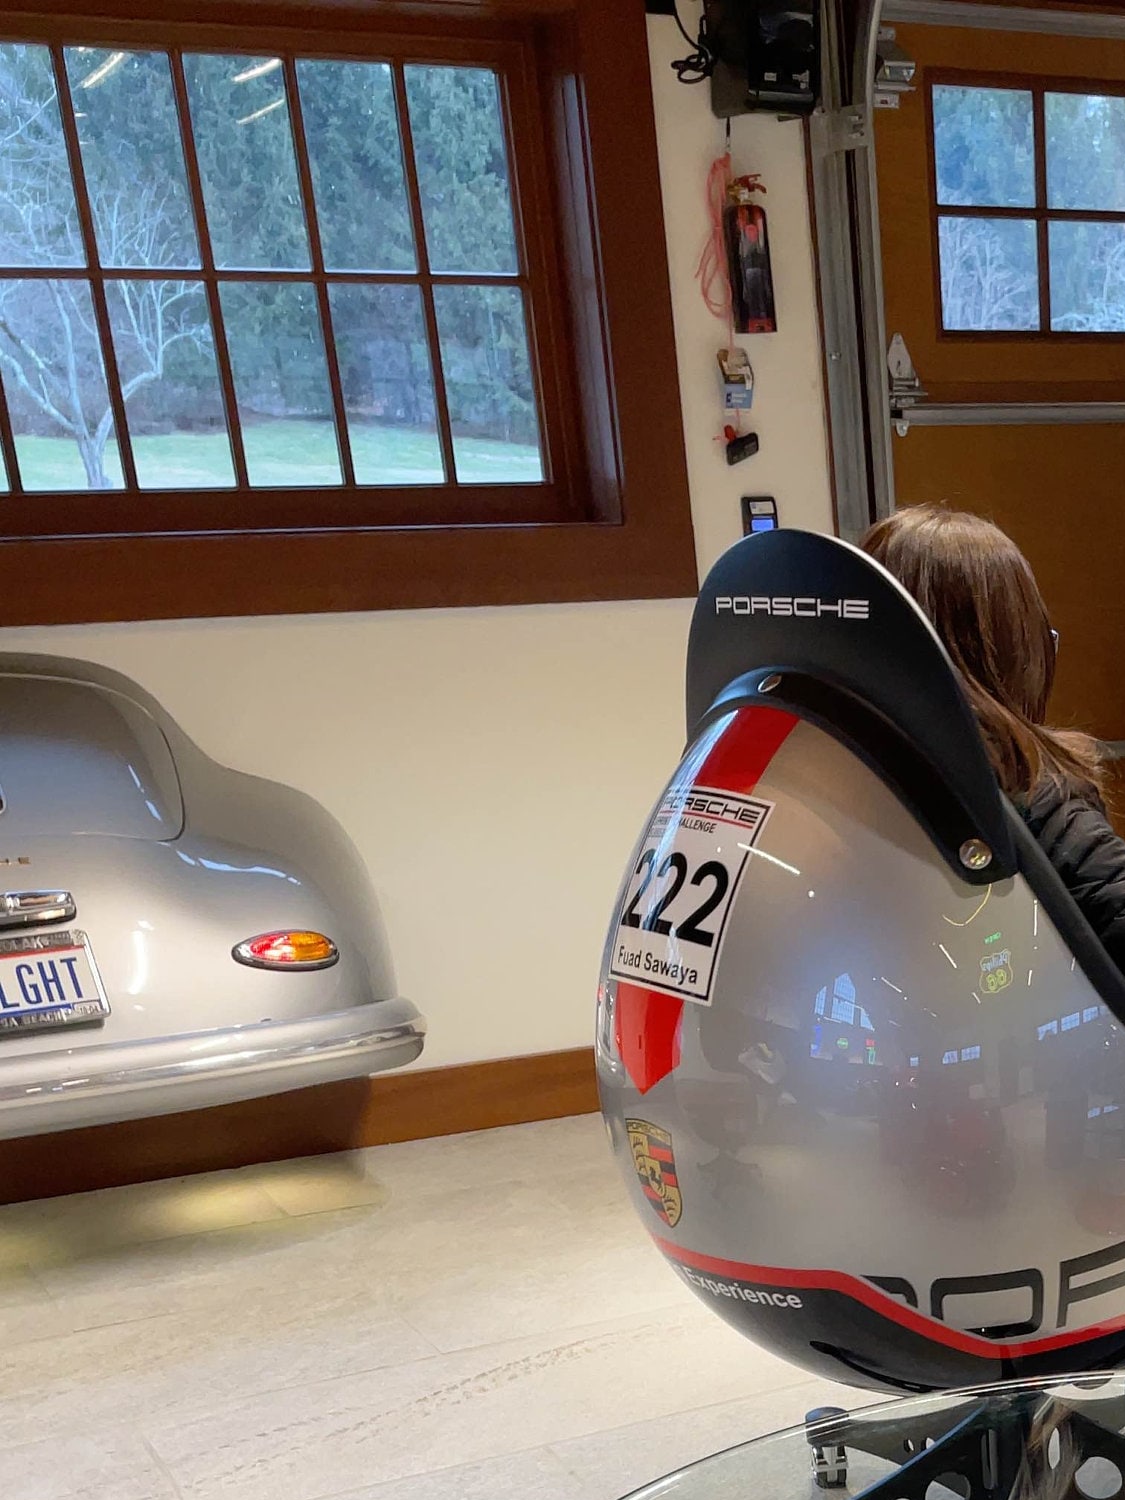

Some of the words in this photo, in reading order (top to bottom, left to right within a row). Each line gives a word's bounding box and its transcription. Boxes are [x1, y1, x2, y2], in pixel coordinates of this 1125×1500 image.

[715, 597, 869, 619] PORSCHE
[664, 793, 761, 824] ORSCHE
[621, 848, 729, 948] 222
[0, 957, 84, 1008] LGHT
[617, 946, 641, 968] Fuad
[644, 952, 698, 985] Sawaya
[680, 1264, 803, 1309] Experience
